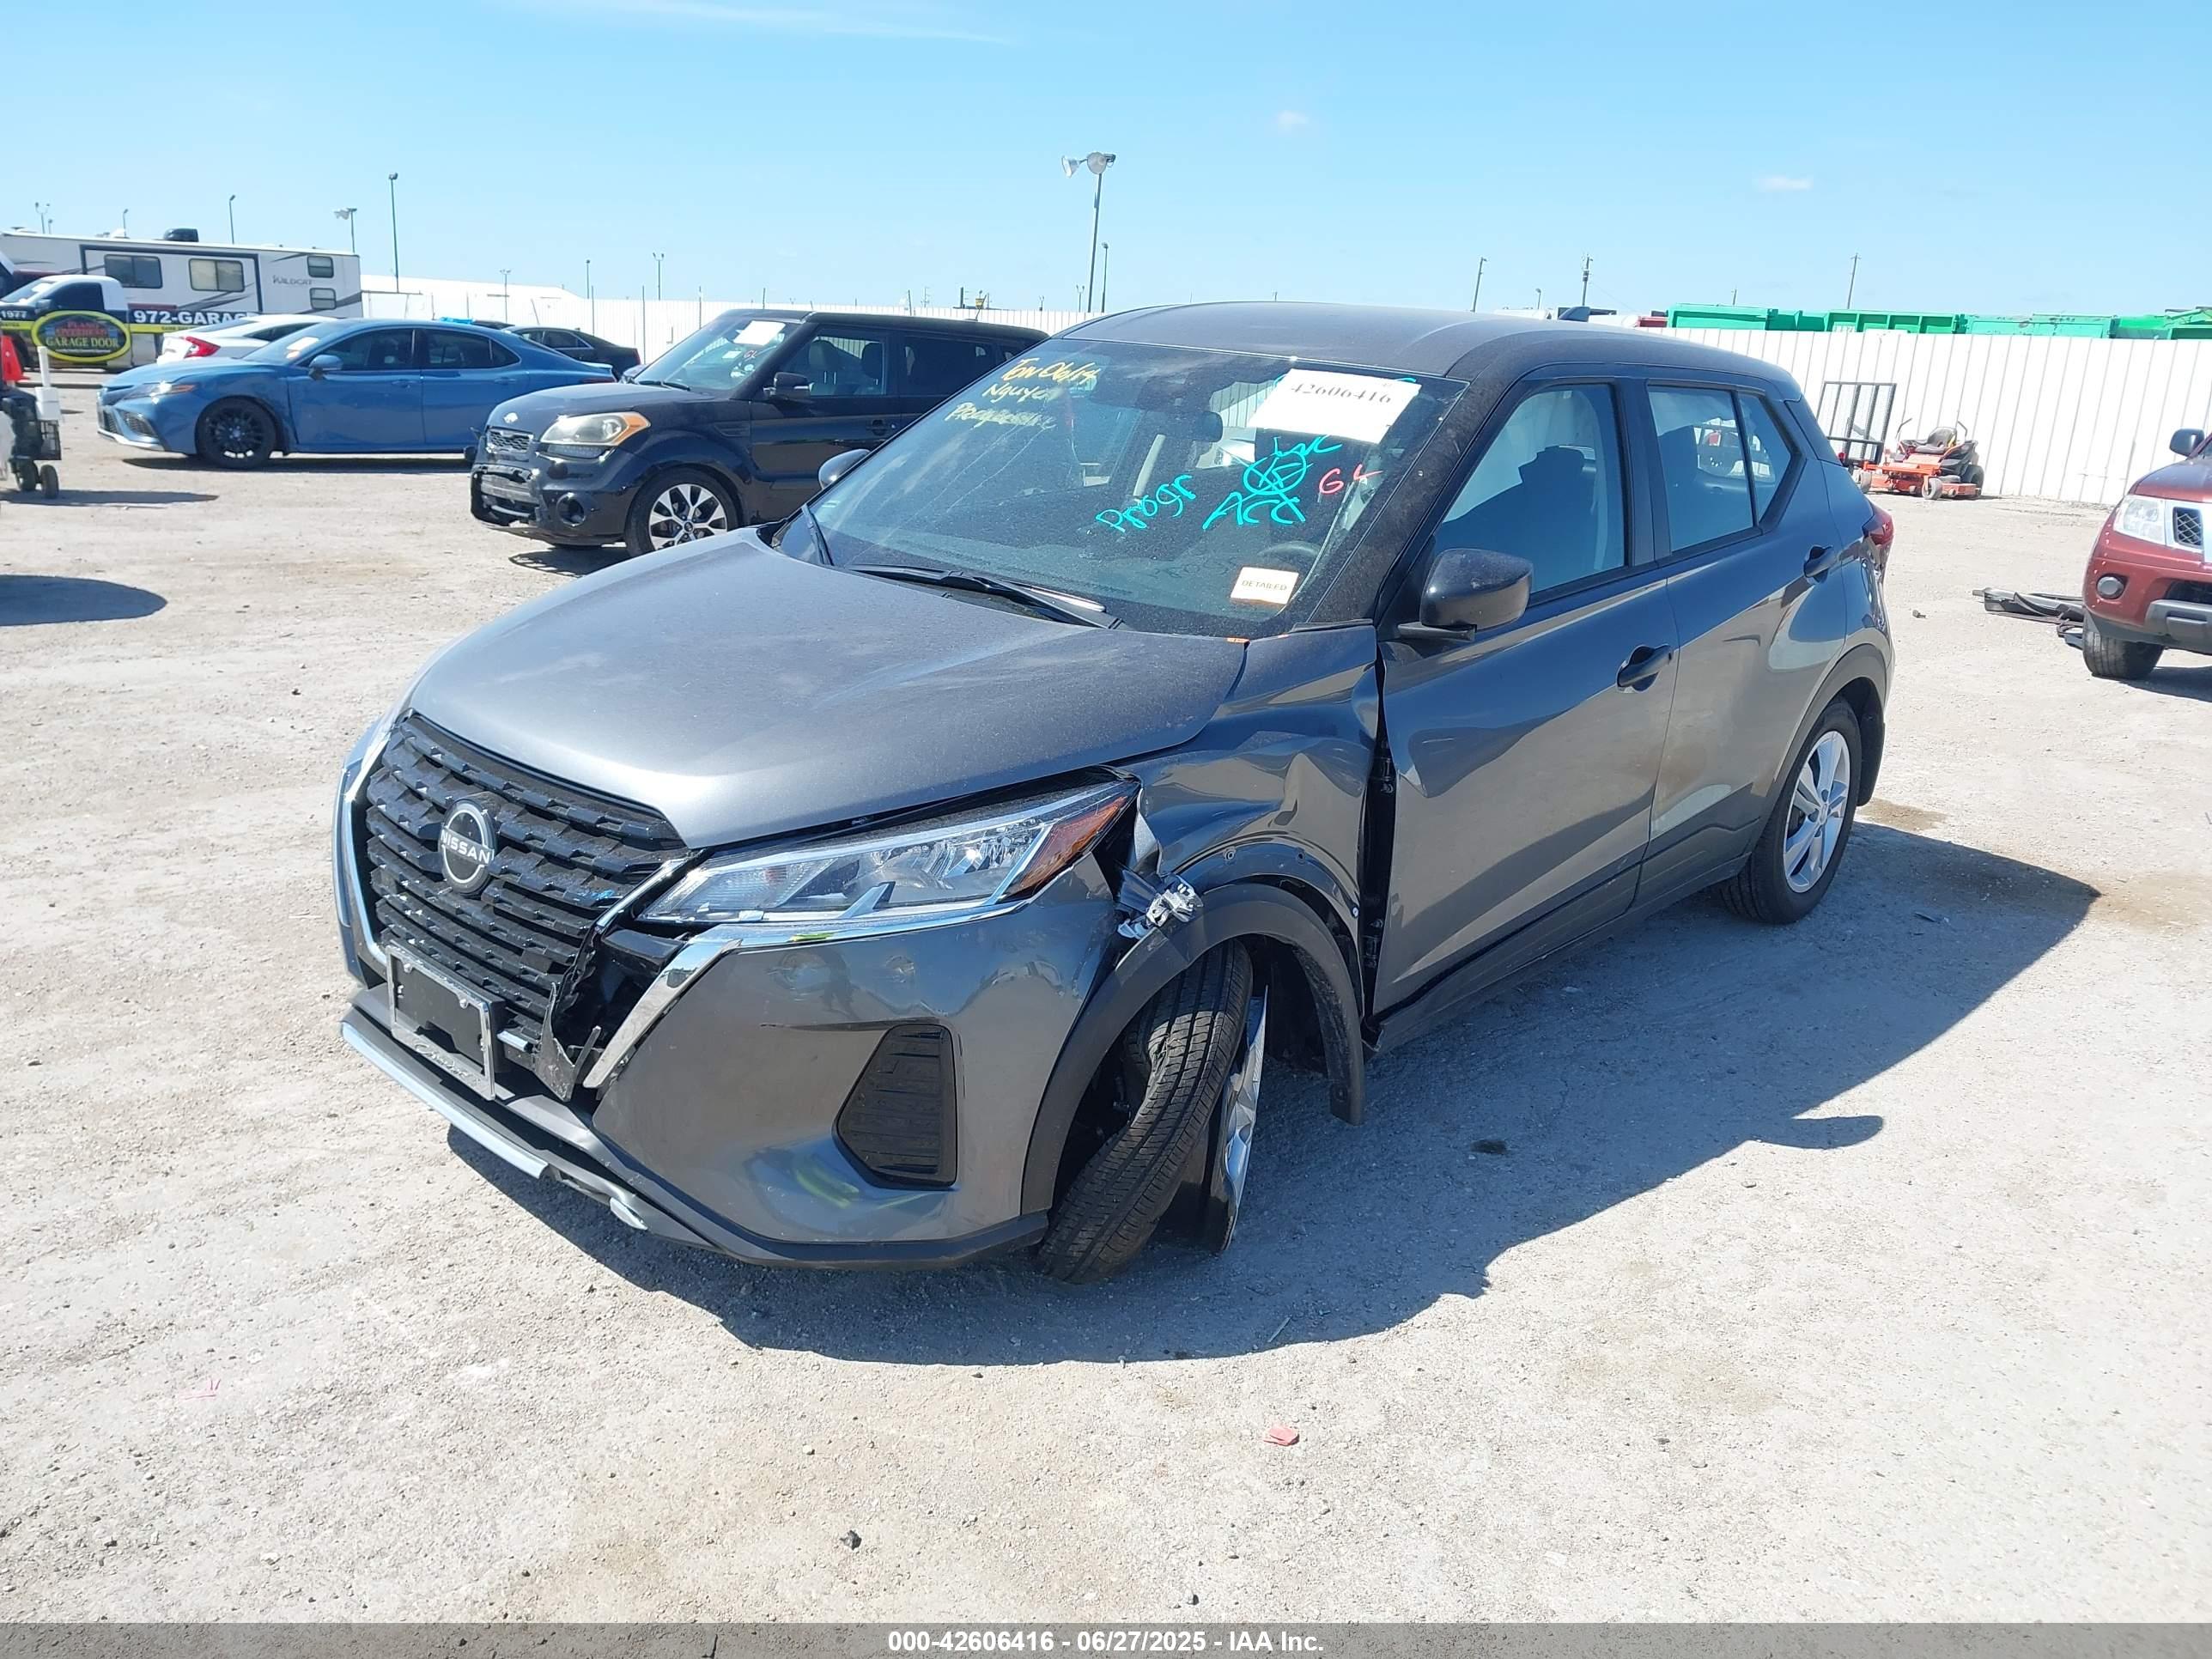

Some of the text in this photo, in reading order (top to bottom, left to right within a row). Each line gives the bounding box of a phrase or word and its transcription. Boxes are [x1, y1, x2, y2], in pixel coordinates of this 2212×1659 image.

[2, 310, 27, 319] 1977
[134, 310, 258, 324] 972-GARAG
[46, 336, 119, 348] GARAGE DOOR
[1291, 383, 1390, 403] 42606416
[441, 830, 492, 865] NISSAN
